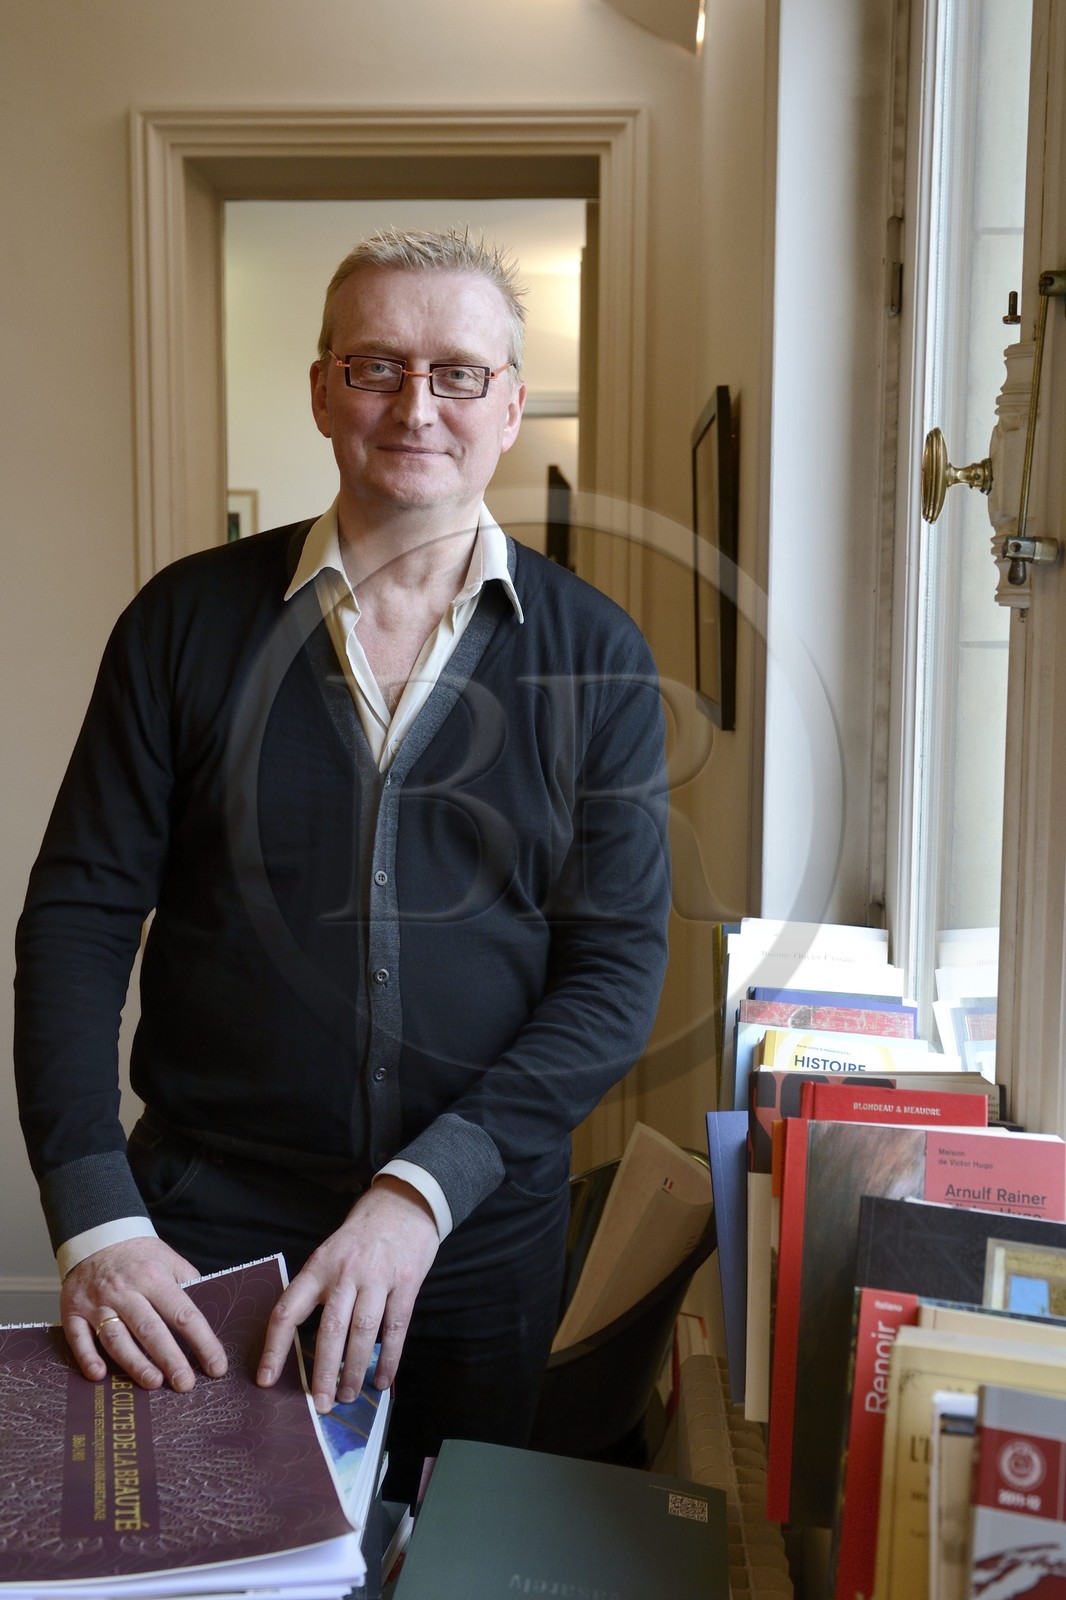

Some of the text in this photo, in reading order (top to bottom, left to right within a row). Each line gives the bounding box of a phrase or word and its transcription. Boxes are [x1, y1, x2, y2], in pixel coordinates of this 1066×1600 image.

[853, 1102, 894, 1112] BLONDEAU
[904, 1106, 941, 1116] MEAUDRE
[938, 1148, 965, 1157] Maison
[950, 1160, 971, 1168] Victor
[973, 1162, 994, 1170] Hugo
[945, 1184, 1047, 1206] Arnulf Rainer
[865, 1320, 896, 1413] Renoir
[112, 1392, 135, 1431] CULTE
[113, 1433, 137, 1450] DE
[114, 1452, 137, 1468] LA
[114, 1469, 150, 1532] BEAUTÉ
